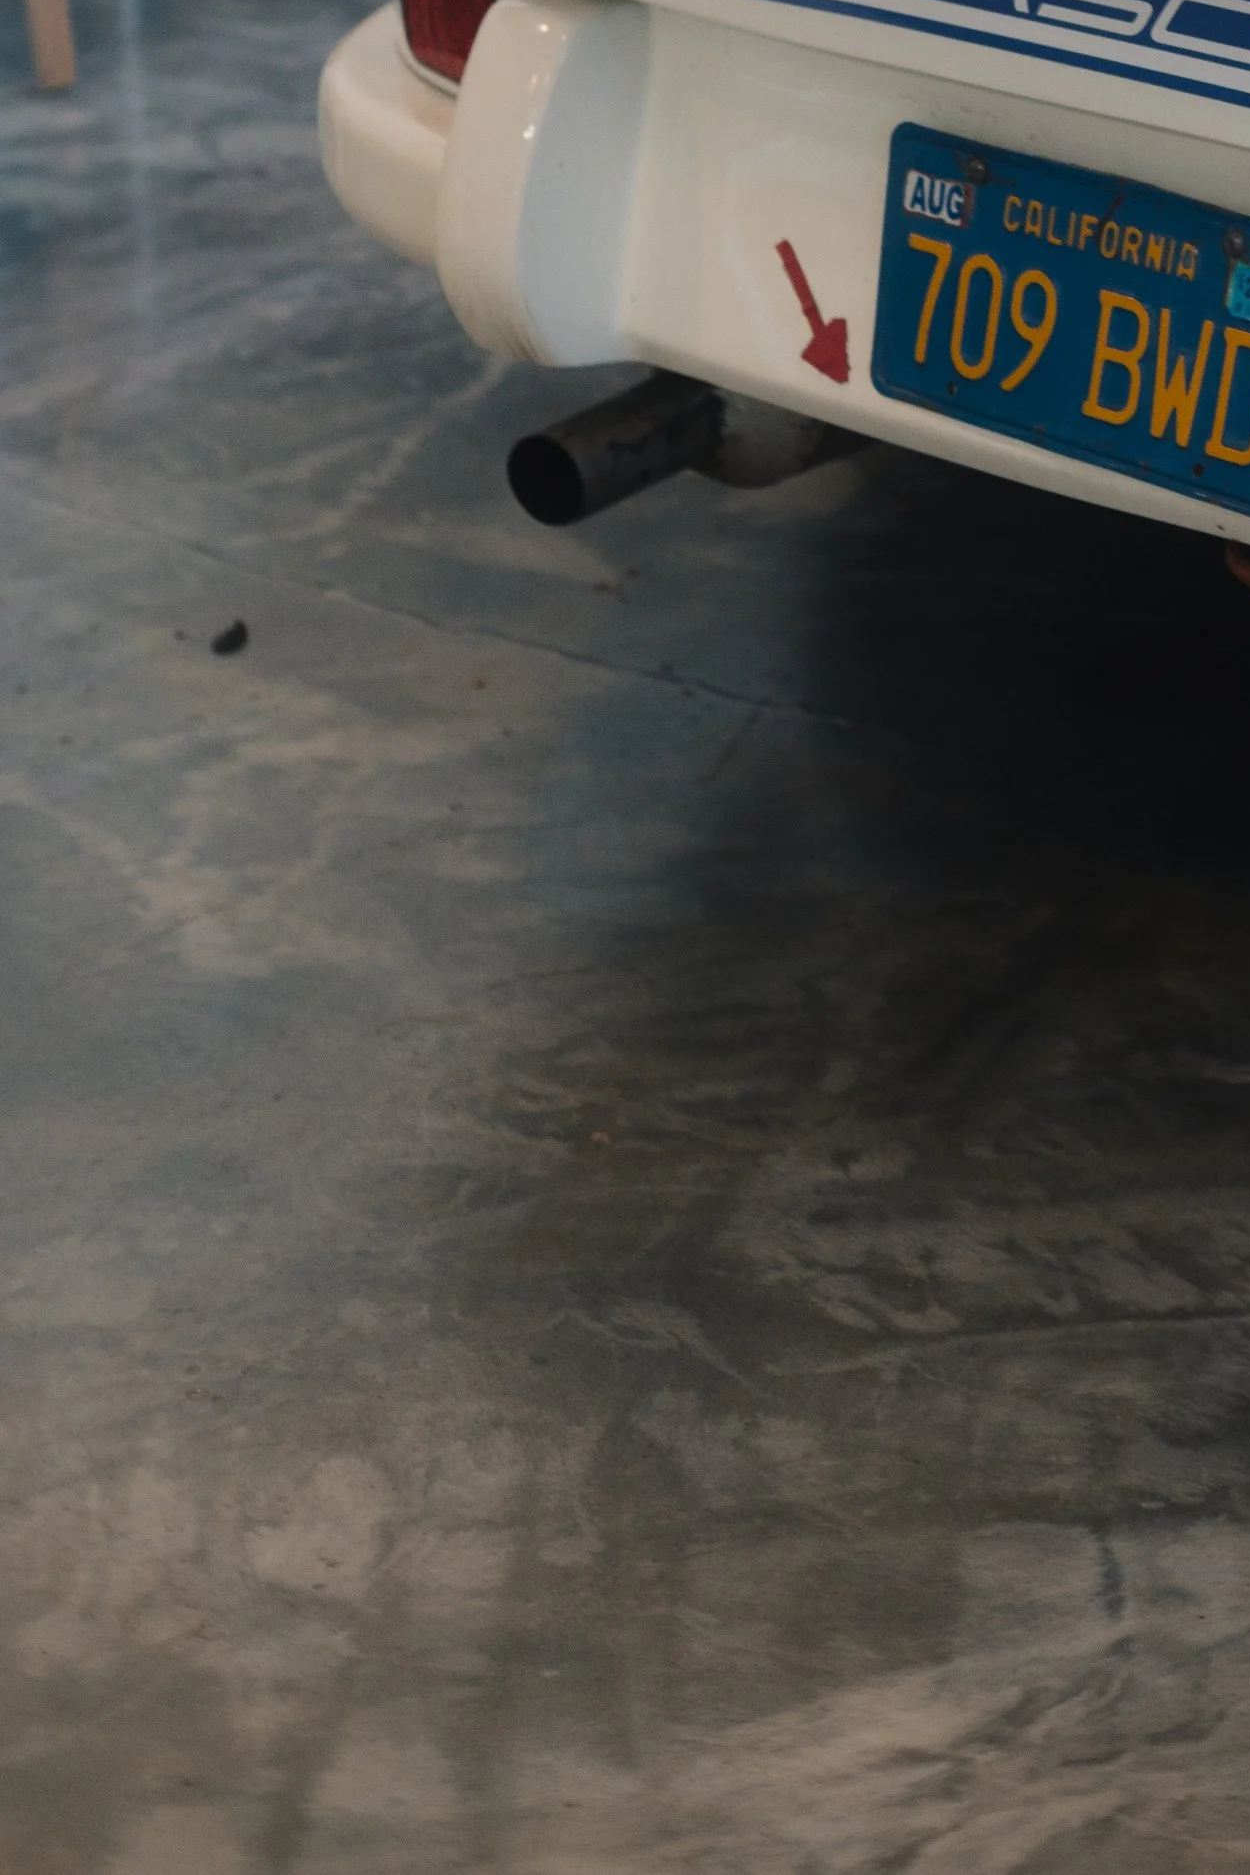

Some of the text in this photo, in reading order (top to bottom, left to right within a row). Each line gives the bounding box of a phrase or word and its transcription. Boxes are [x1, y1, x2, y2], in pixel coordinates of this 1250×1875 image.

[909, 176, 967, 221] AUG
[1003, 194, 1203, 283] CALIFORNIA
[908, 232, 1059, 393] 709
